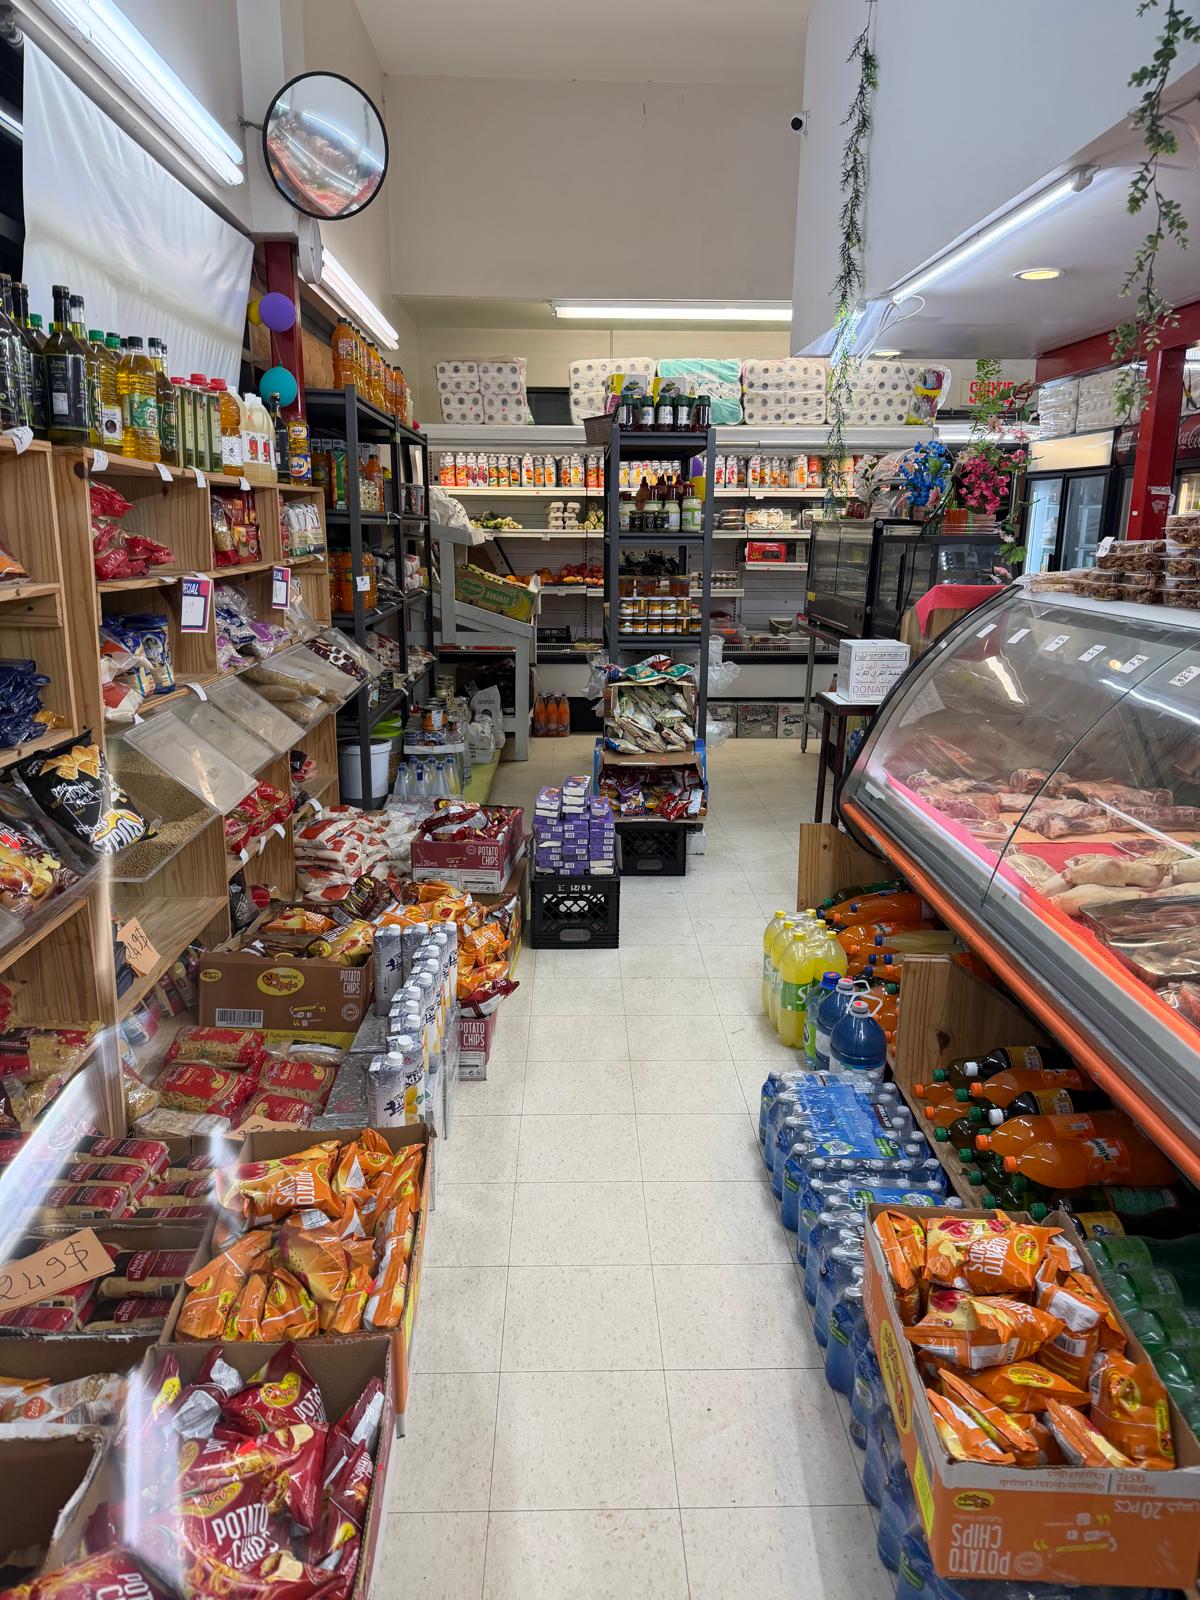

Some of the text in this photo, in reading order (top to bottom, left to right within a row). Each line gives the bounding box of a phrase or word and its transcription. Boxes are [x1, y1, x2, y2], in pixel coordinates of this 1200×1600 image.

[477, 846, 499, 856] POTATO
[481, 856, 499, 866] CHIPS
[340, 970, 361, 982] POTATO
[343, 981, 360, 994] CHIPS
[463, 1033, 485, 1047] CHIPS
[1114, 1499, 1141, 1513] PCS
[211, 1503, 270, 1546] POTATO
[949, 1523, 1002, 1549] CHIPS
[948, 1547, 1011, 1575] POTATO
